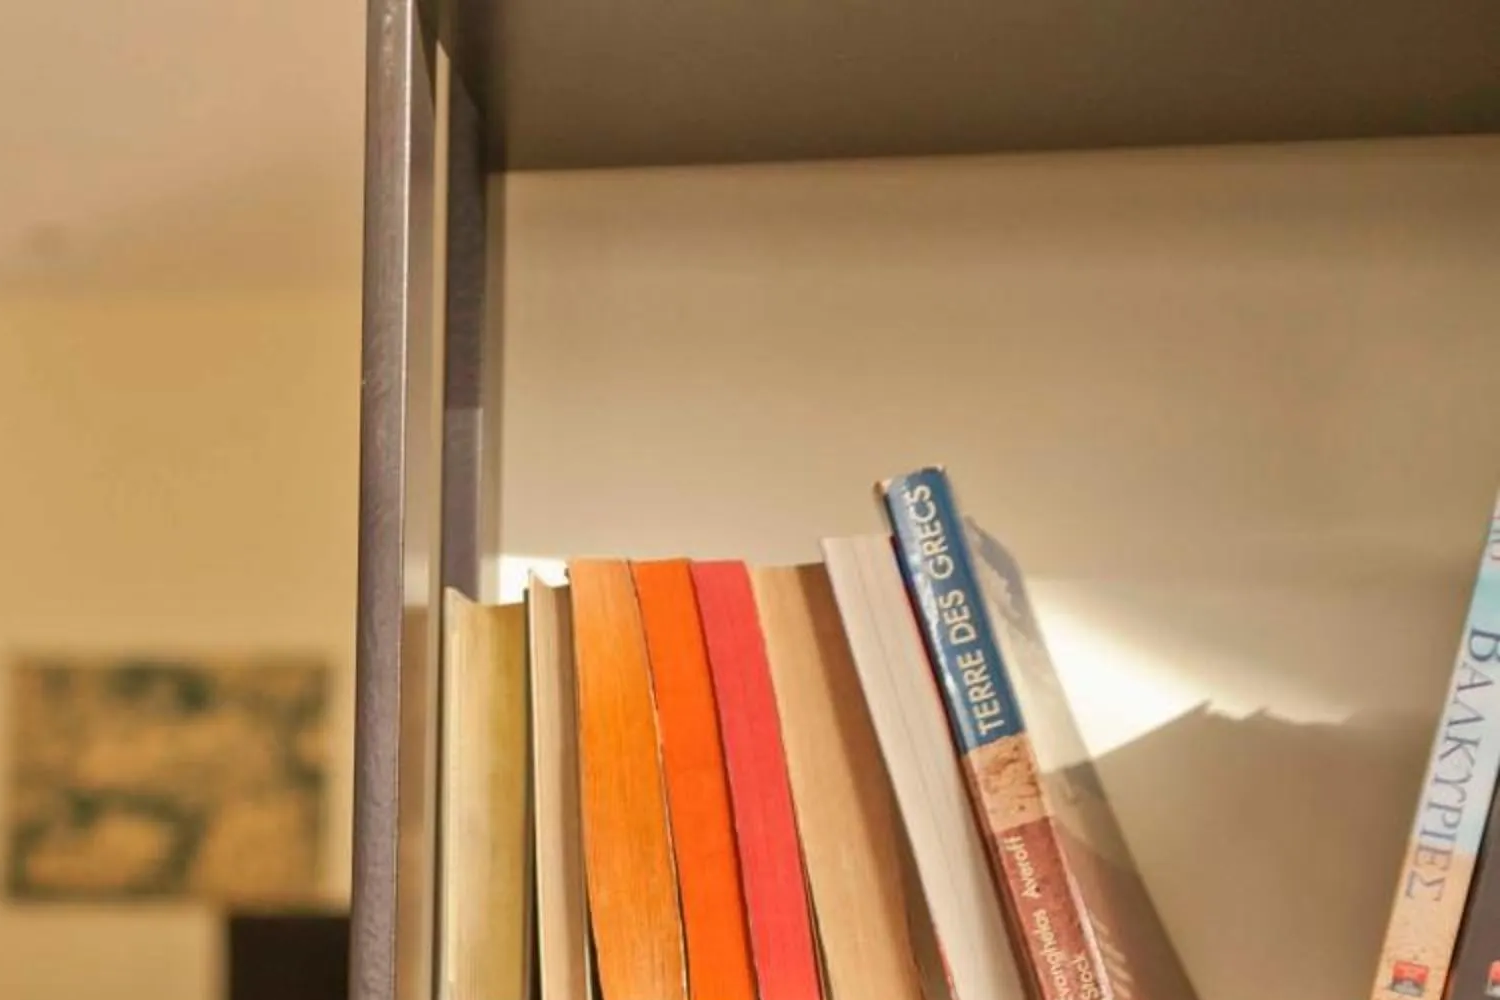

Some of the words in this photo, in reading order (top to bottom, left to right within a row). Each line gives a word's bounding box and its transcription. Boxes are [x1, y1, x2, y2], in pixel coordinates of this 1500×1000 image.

[903, 484, 955, 580] GRECS
[939, 590, 977, 645] DES
[957, 650, 1005, 735] TERRE
[1406, 628, 1500, 902] ΒΑΛΚΥΡΙΕΣ
[1004, 836, 1042, 899] Averoff
[1069, 952, 1100, 1000] Stock
